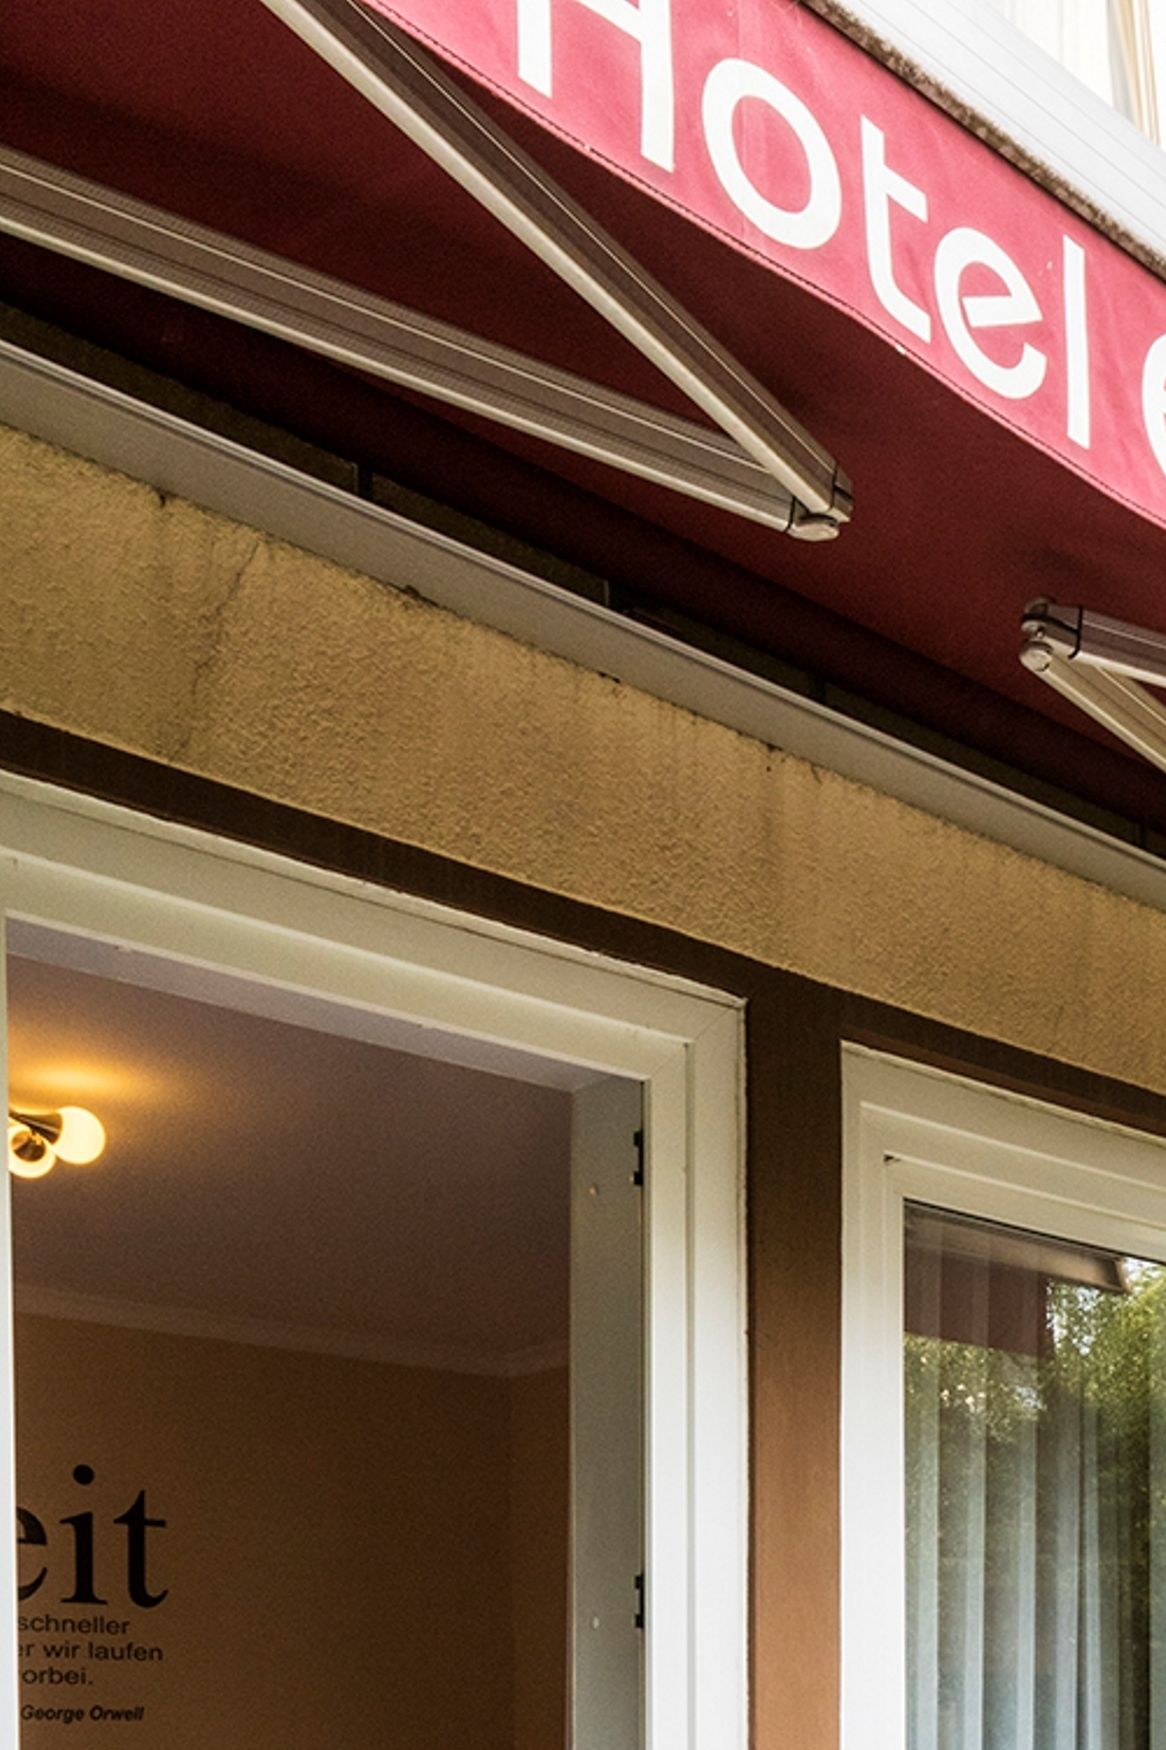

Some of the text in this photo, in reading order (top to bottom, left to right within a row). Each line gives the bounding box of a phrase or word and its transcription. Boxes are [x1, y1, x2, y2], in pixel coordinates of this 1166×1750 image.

[517, 0, 1091, 450] Hotel
[19, 1614, 130, 1635] schneller
[43, 1640, 80, 1658] wir
[88, 1642, 163, 1661] laufen
[21, 1704, 144, 1724] George Orwell
